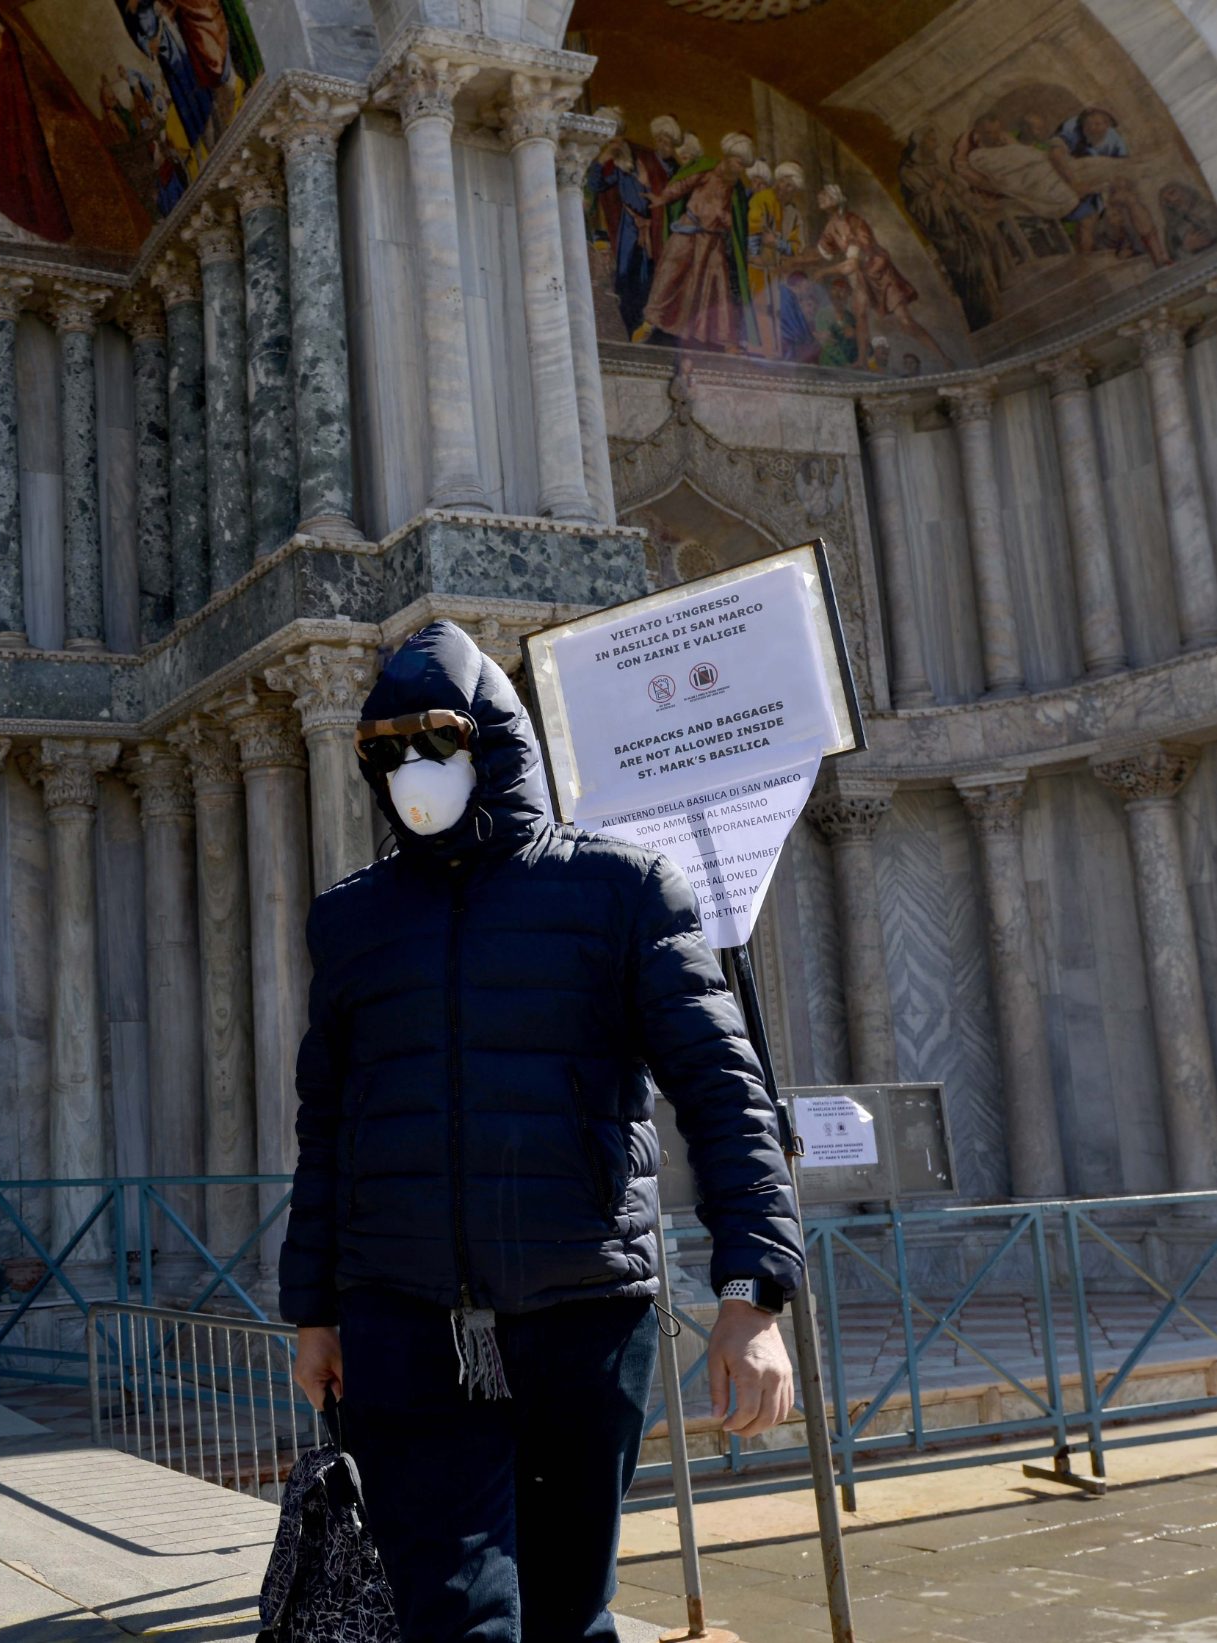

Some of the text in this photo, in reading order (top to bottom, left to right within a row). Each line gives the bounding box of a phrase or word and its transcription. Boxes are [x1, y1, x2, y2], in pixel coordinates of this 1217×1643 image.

[595, 603, 763, 662] IN BASILICA DI SAN MARCO
[610, 594, 740, 641] VIETATO L'INGRESSO
[617, 623, 747, 670] CON ZAINI E VALIGIE
[614, 701, 784, 755] BACKPACKS AND BAGGAGES
[619, 717, 784, 769] ARE NOT ALLOWED INSIDE
[637, 737, 770, 780] ST. MARK'S BASILICA
[601, 773, 801, 828] ALL'INTERNO DELLA BASILICA DI SAN MARCO
[636, 798, 768, 836] SONO AMMESSI AL MASSIMO
[678, 808, 797, 842] CONTEMPORANEAMENTE
[686, 856, 735, 874] MAXIMUM
[712, 868, 758, 885] ALLOWED
[704, 904, 748, 920] ONE TIME
[715, 892, 725, 901] DI
[726, 887, 747, 899] SAN
